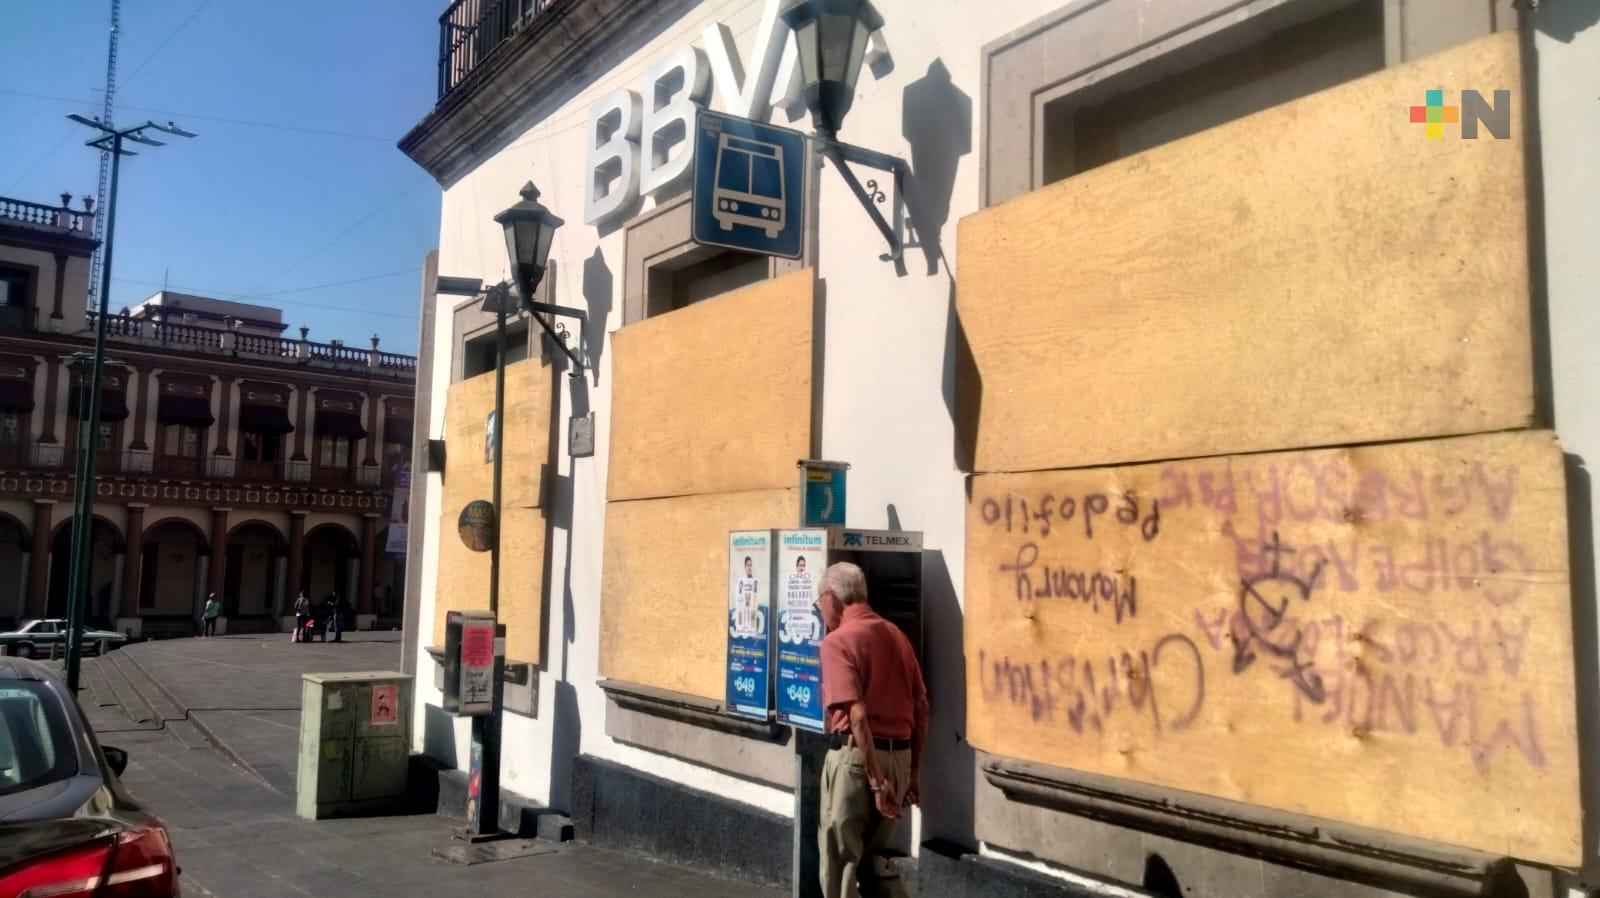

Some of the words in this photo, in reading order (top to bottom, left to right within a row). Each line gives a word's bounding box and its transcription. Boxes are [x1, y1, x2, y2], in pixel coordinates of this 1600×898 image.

[733, 536, 766, 546] infinitum
[783, 533, 822, 545] infinitum
[865, 536, 910, 546] TELMEX
[789, 573, 811, 581] ORO
